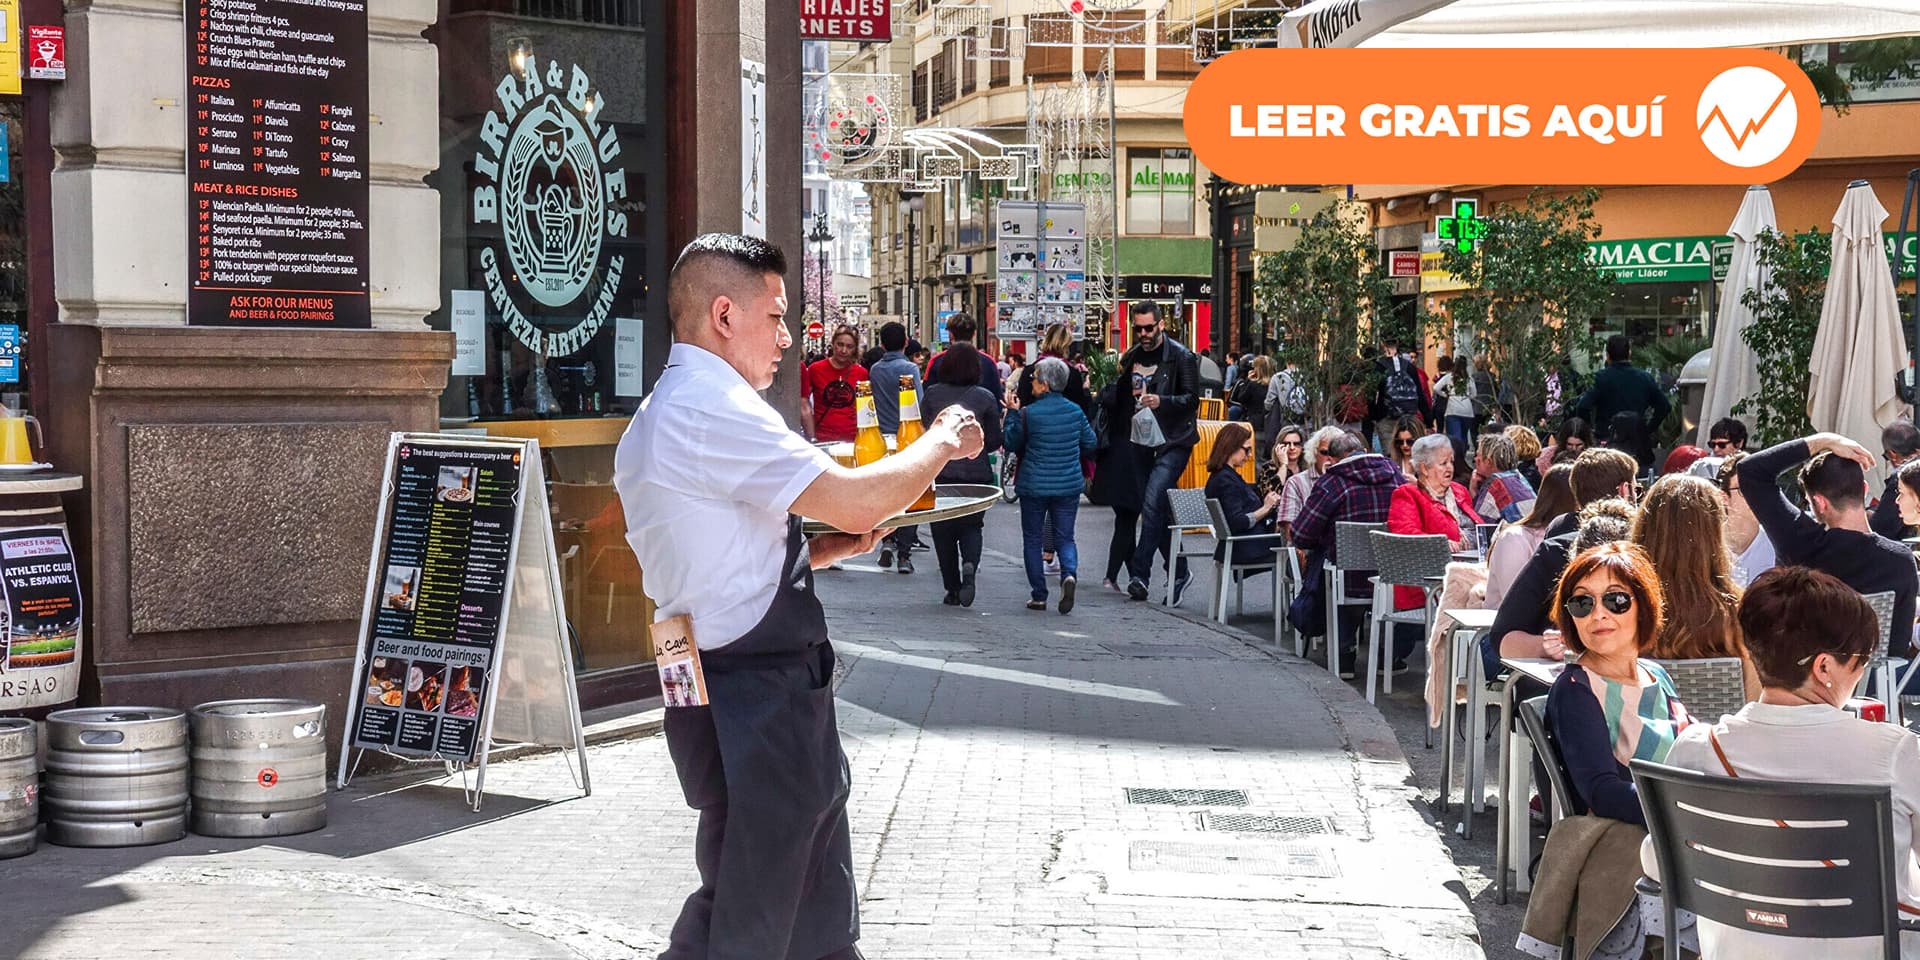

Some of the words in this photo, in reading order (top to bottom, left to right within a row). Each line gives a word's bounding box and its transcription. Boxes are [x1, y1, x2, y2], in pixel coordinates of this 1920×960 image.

[209, 0, 227, 9] Spicy
[228, 0, 256, 10] potatoes
[327, 0, 345, 11] honey
[347, 2, 364, 11] sauce
[209, 9, 226, 20] Crisp
[228, 10, 249, 22] shrimp
[251, 12, 271, 24] fritters
[272, 16, 276, 24] 4
[210, 21, 234, 32] Nachos
[235, 24, 249, 33] with
[266, 27, 287, 37] cheese
[288, 30, 300, 39] and
[301, 32, 334, 43] guacamole
[209, 33, 233, 44] Crunch
[234, 35, 251, 46] Blues
[252, 37, 275, 48] Prawns
[210, 45, 226, 55] Fried
[227, 48, 243, 58] eggs
[244, 49, 258, 58] with
[259, 50, 280, 60] Iberian
[298, 54, 316, 64] truffle
[317, 56, 329, 65] and
[330, 57, 346, 69] chips
[210, 57, 222, 67] Mix
[223, 58, 230, 68] of
[231, 59, 246, 69] fried
[247, 62, 273, 72] calamari
[274, 64, 286, 73] and
[287, 64, 298, 74] fish
[299, 65, 306, 75] of
[306, 66, 316, 76] the
[317, 67, 329, 79] day
[192, 75, 231, 88] PIZZAS
[211, 94, 235, 106] Italiana
[265, 100, 300, 112] Affumicatta
[331, 105, 352, 117] Funghi
[212, 112, 244, 123] Prosciutto
[265, 115, 288, 126] Diavola
[212, 128, 237, 138] Serrano
[331, 122, 355, 132] Calzone
[265, 132, 272, 141] Di
[273, 132, 293, 142] Tonno
[331, 137, 348, 149] Cracy
[212, 144, 240, 155] Marinara
[265, 148, 288, 158] Tartufo
[474, 55, 544, 224] BIRRA
[546, 60, 564, 90] &
[566, 64, 628, 239] BLUES
[332, 153, 355, 163] Salmon
[213, 160, 244, 171] Luminosa
[265, 164, 299, 176] Vegetables
[332, 168, 361, 180] Margarita
[194, 182, 223, 193] MEAT
[225, 184, 233, 194] &
[236, 185, 258, 195] RICE
[261, 186, 298, 197] DISHES
[212, 200, 243, 210] Valencian
[266, 204, 295, 213] Minimum
[296, 205, 305, 214] for
[306, 206, 310, 214] 2
[334, 208, 341, 216] 40
[212, 212, 226, 222] Red
[227, 214, 252, 223] seafood
[274, 216, 303, 226] Minimum
[304, 217, 313, 226] for
[314, 218, 318, 226] 2
[342, 220, 349, 228] 35
[213, 224, 240, 236] Senyoret
[255, 226, 285, 236] Minimum
[286, 227, 295, 237] for
[296, 229, 300, 237] 2
[324, 230, 331, 239] 35
[213, 236, 233, 246] Baked
[234, 238, 248, 248] pork
[250, 238, 262, 247] ribs
[213, 248, 228, 257] Pork
[229, 249, 261, 259] tenderloin
[263, 250, 276, 260] with
[278, 253, 300, 262] pepper
[308, 252, 336, 263] roquefort
[337, 255, 354, 263] sauce
[214, 260, 232, 269] 100%
[242, 261, 264, 272] burger
[265, 262, 278, 271] with
[280, 264, 290, 272] our
[291, 264, 312, 274] special
[313, 264, 340, 274] barbecue
[341, 266, 357, 274] sauce
[213, 271, 233, 281] Pulled
[235, 273, 250, 284] pork
[251, 273, 272, 285] burger
[1142, 283, 1152, 293] El
[1200, 284, 1211, 293] de
[230, 296, 250, 307] ASK
[253, 296, 272, 308] FOR
[274, 297, 296, 309] OUR
[299, 298, 334, 310] MENUS
[480, 246, 542, 354] CERVEZA
[547, 255, 624, 358] ARTESANAL
[229, 310, 248, 318] AND
[250, 310, 268, 319] BEER
[270, 311, 276, 319] &
[277, 311, 298, 320] FOOD
[300, 311, 334, 321] PAIRINGS
[423, 449, 433, 457] best
[434, 450, 463, 458] suggestions
[469, 452, 496, 460] accompany
[7, 540, 34, 549] VIERNES
[5, 564, 52, 577] ATHLETIC
[53, 563, 72, 572] CLUB
[10, 578, 28, 588] VS.
[30, 575, 72, 586] ESPANYOL
[461, 604, 483, 612] Desserts
[377, 640, 400, 654] Beer
[401, 644, 419, 656] and
[421, 645, 443, 658] food
[444, 649, 486, 665] pairings:
[1757, 914, 1785, 924] AMBAR
